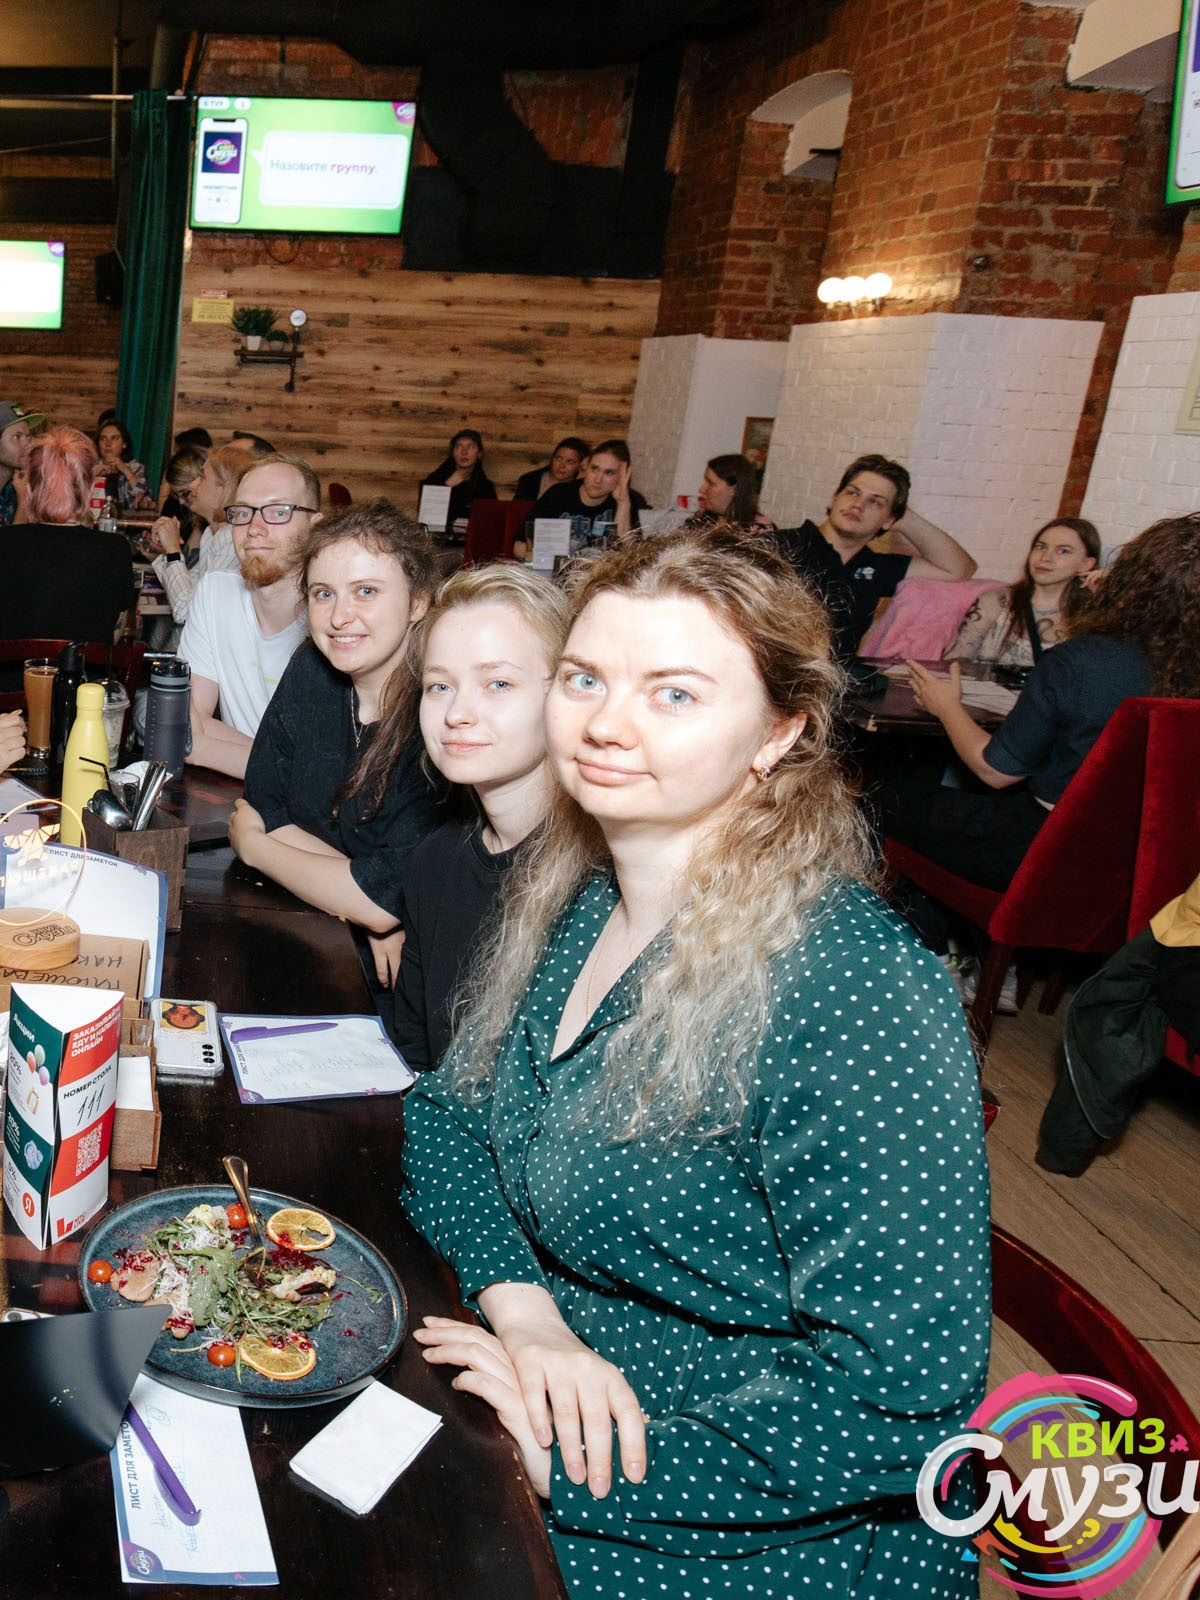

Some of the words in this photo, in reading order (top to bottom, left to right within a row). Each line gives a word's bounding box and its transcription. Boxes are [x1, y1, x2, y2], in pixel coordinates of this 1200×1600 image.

[270, 159, 328, 173] Назовите
[49, 848, 69, 857] ЛИСТ
[86, 855, 119, 868] ЗАМЕТОК
[63, 1081, 92, 1100] НОМЕР
[92, 1064, 112, 1085] СТОЛА
[120, 1417, 135, 1460] ЗАМЕТО
[126, 1460, 140, 1482] ДЛЯ
[129, 1482, 142, 1511] ЛИСТ
